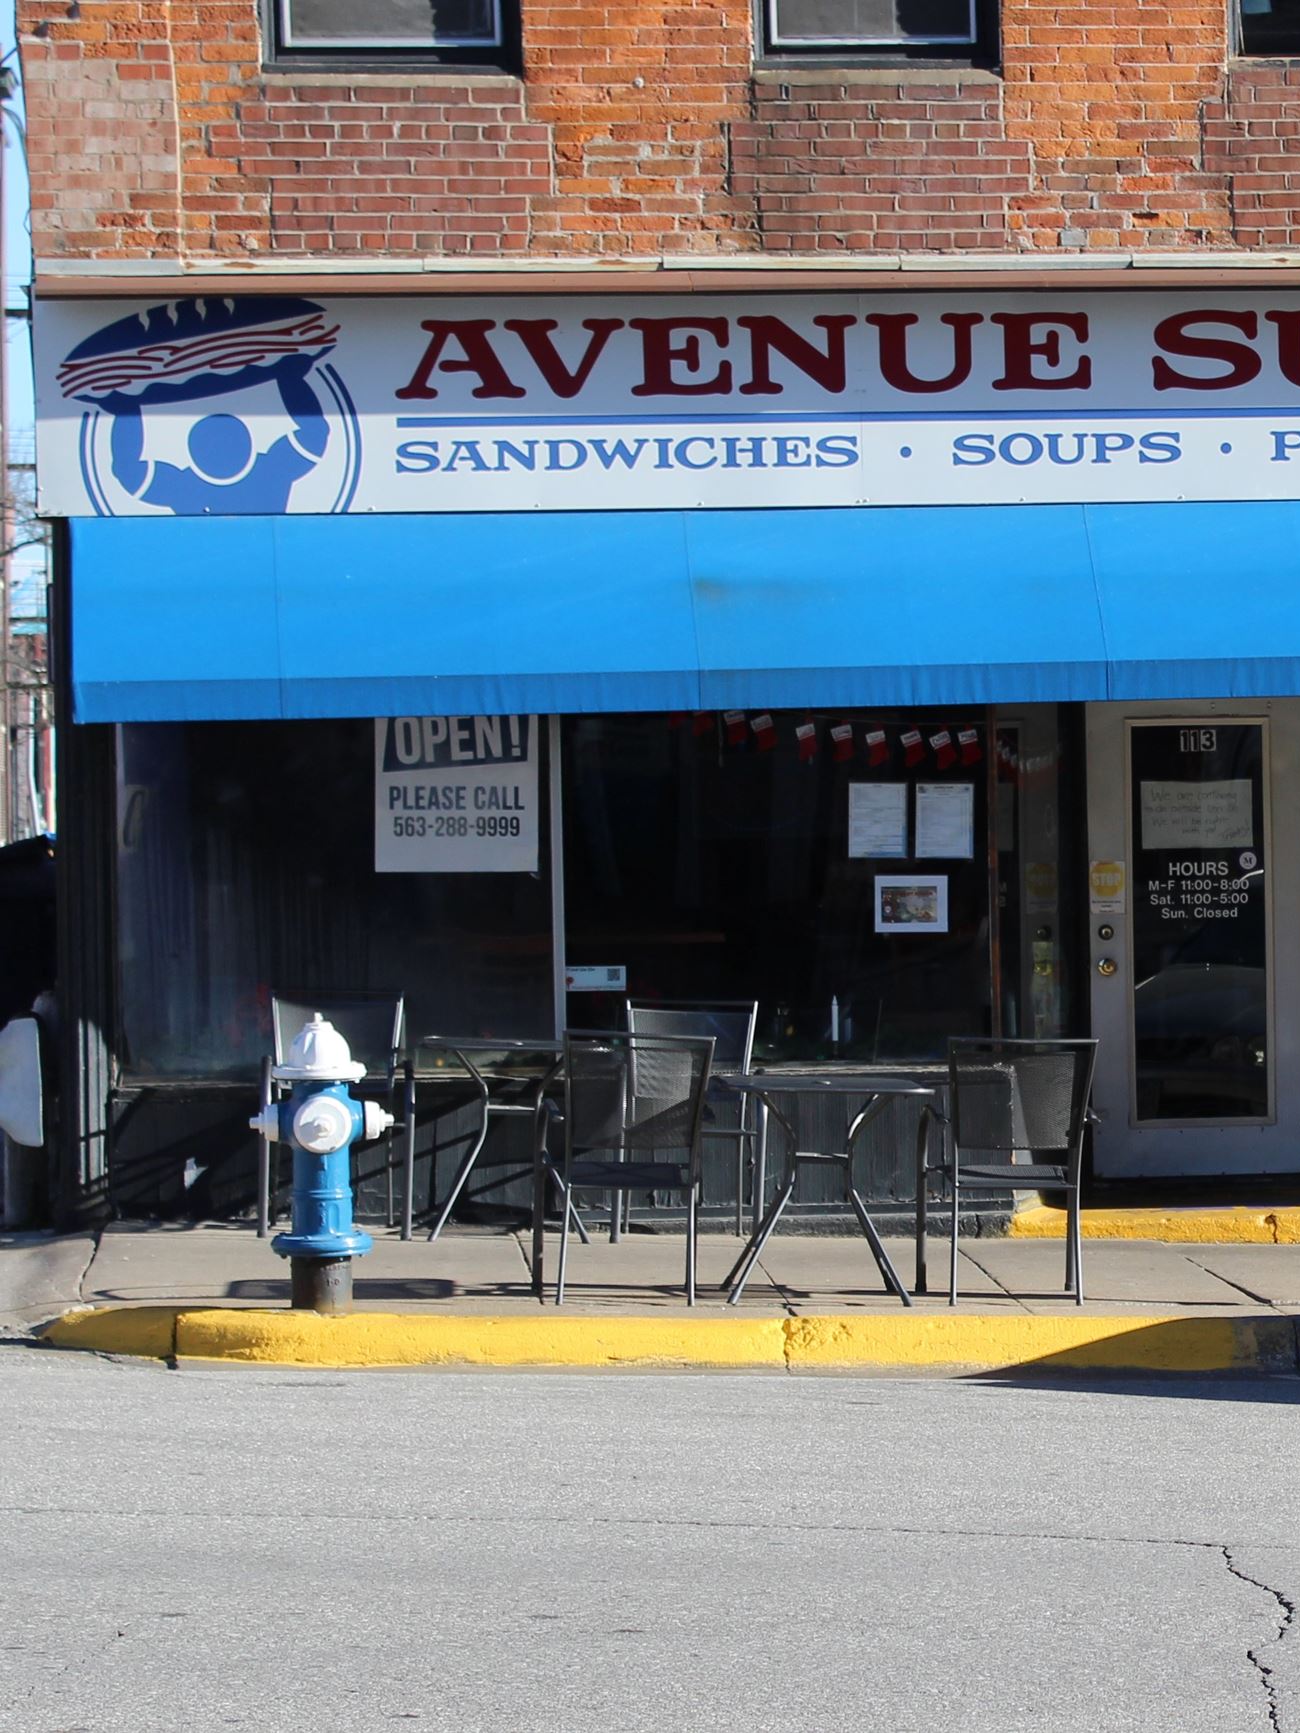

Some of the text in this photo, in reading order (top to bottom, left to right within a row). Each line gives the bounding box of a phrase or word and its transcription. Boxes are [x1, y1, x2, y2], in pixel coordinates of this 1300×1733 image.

[396, 313, 1089, 401] AVENUE
[394, 434, 859, 475] SANDWICHES
[951, 430, 1182, 466] SOUPS
[394, 715, 521, 765] OPEN!
[1180, 729, 1216, 752] 113
[389, 785, 525, 810] PLEASE CALL
[393, 816, 520, 837] 563-288-9999
[1092, 872, 1121, 886] STOP
[1169, 861, 1229, 876] HOURS
[1148, 879, 1250, 891] M-F 11:00-8:00
[1150, 892, 1249, 905] Sat. 11:00-5:00
[1161, 906, 1238, 919] Sun. Closed
